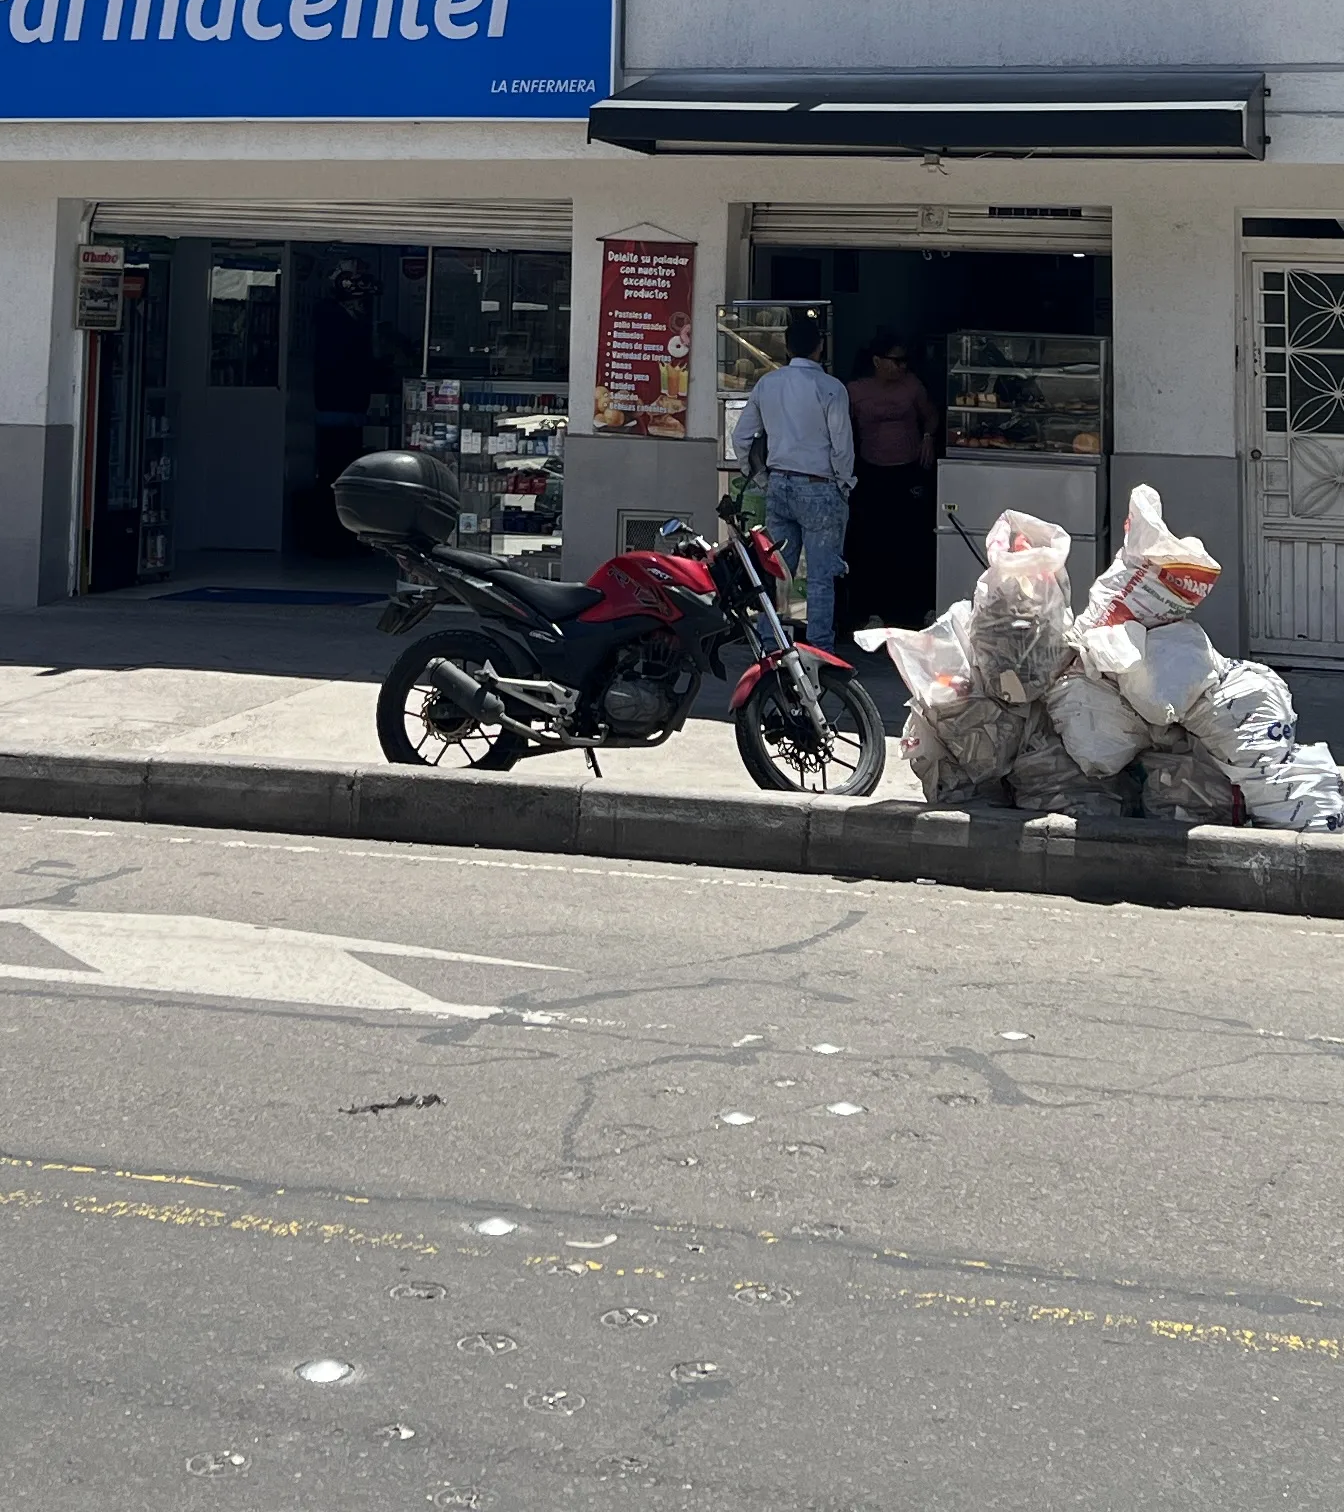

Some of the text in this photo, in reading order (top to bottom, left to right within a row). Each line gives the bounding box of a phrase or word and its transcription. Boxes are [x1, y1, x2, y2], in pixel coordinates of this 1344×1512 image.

[491, 79, 596, 94] LA ENFERMERA
[607, 251, 689, 266] Deleite su paladar
[619, 266, 676, 277] con nuestros
[623, 277, 671, 288] excelentes
[624, 288, 669, 300] productos
